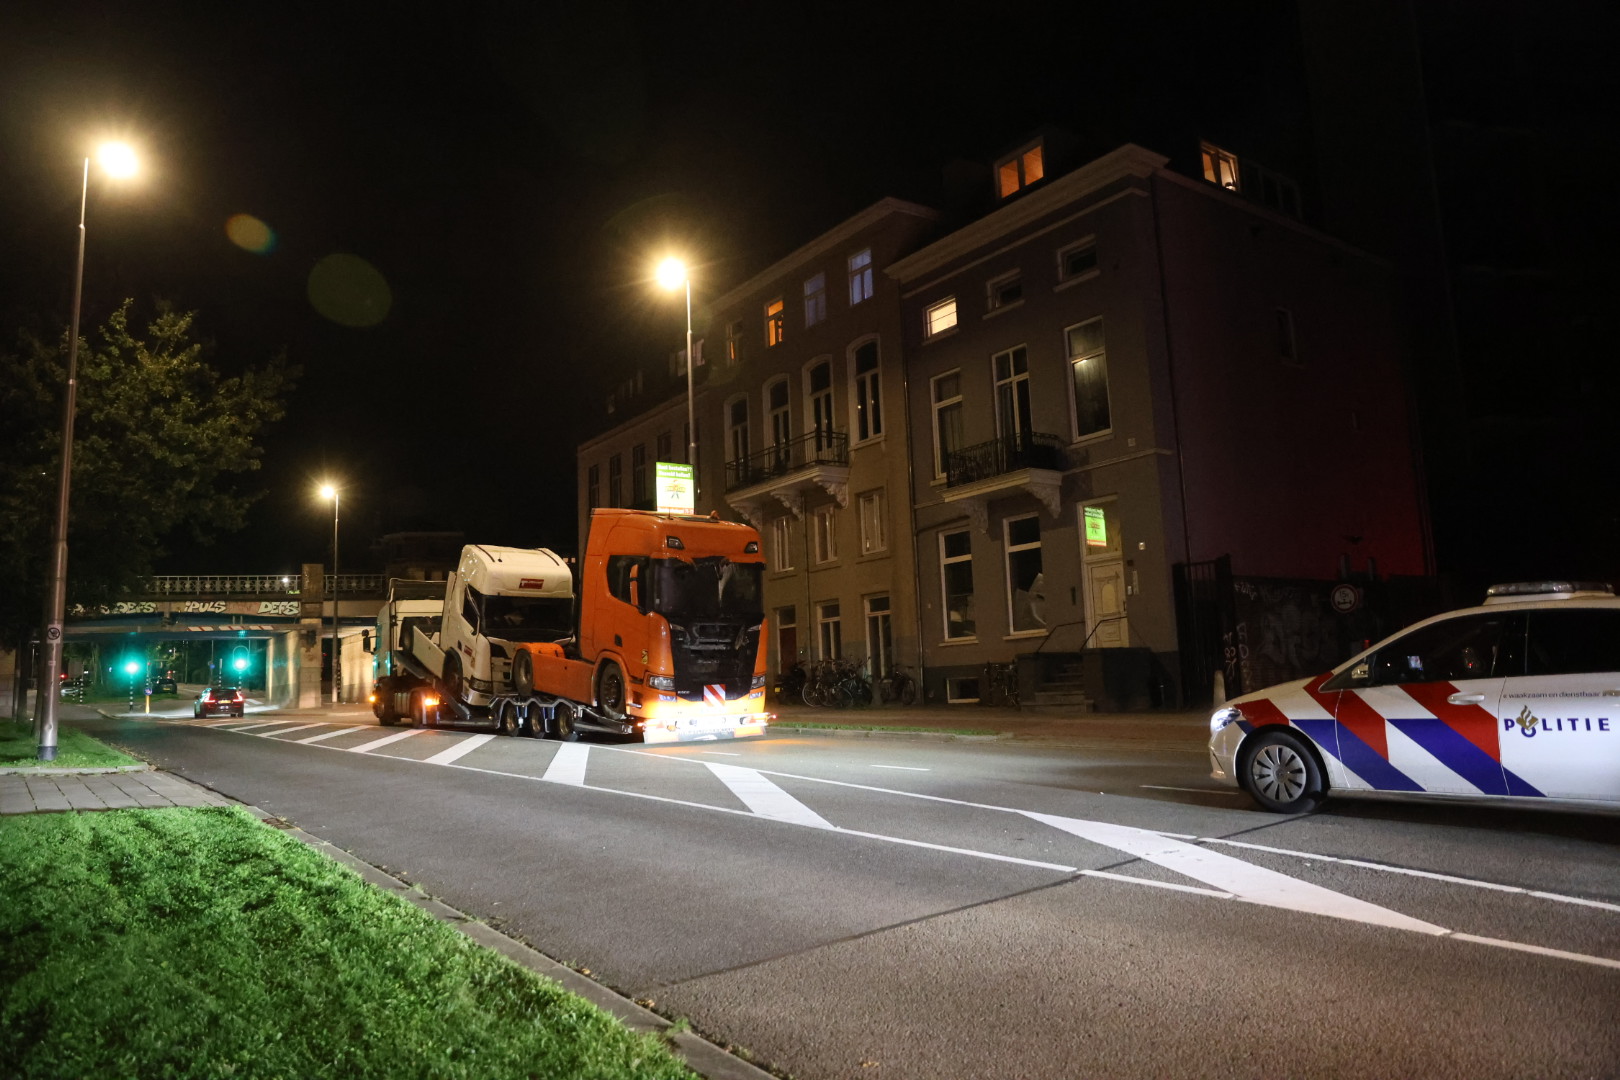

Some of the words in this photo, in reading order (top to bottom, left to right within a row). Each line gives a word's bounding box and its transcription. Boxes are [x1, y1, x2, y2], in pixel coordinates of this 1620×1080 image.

[258, 601, 299, 615] DEFS
[1559, 690, 1600, 698] dienstbaar
[1504, 717, 1610, 737] POLITIE
